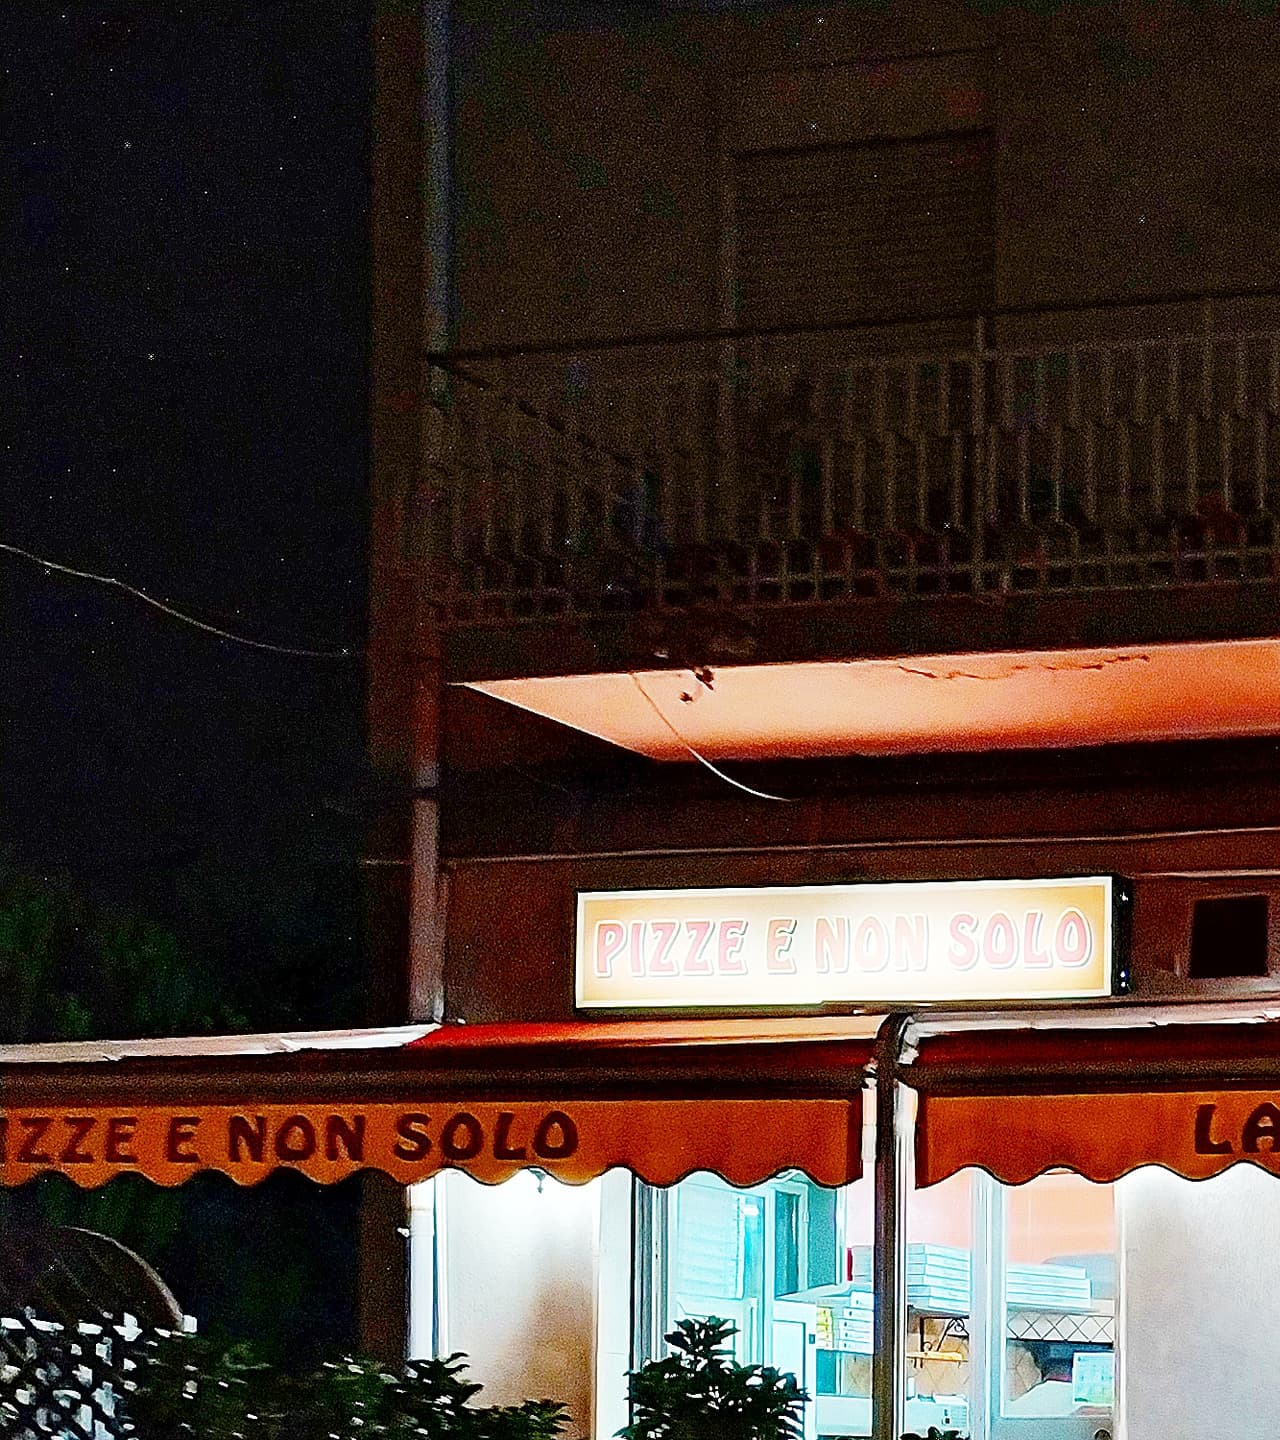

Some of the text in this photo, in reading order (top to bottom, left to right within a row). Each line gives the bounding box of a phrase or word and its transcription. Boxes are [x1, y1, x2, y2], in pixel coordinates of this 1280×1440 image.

[594, 907, 1094, 978] PIZZE E NON SOLO
[167, 1116, 201, 1163] E
[229, 1113, 367, 1164] NON
[393, 1110, 579, 1162] SOLO
